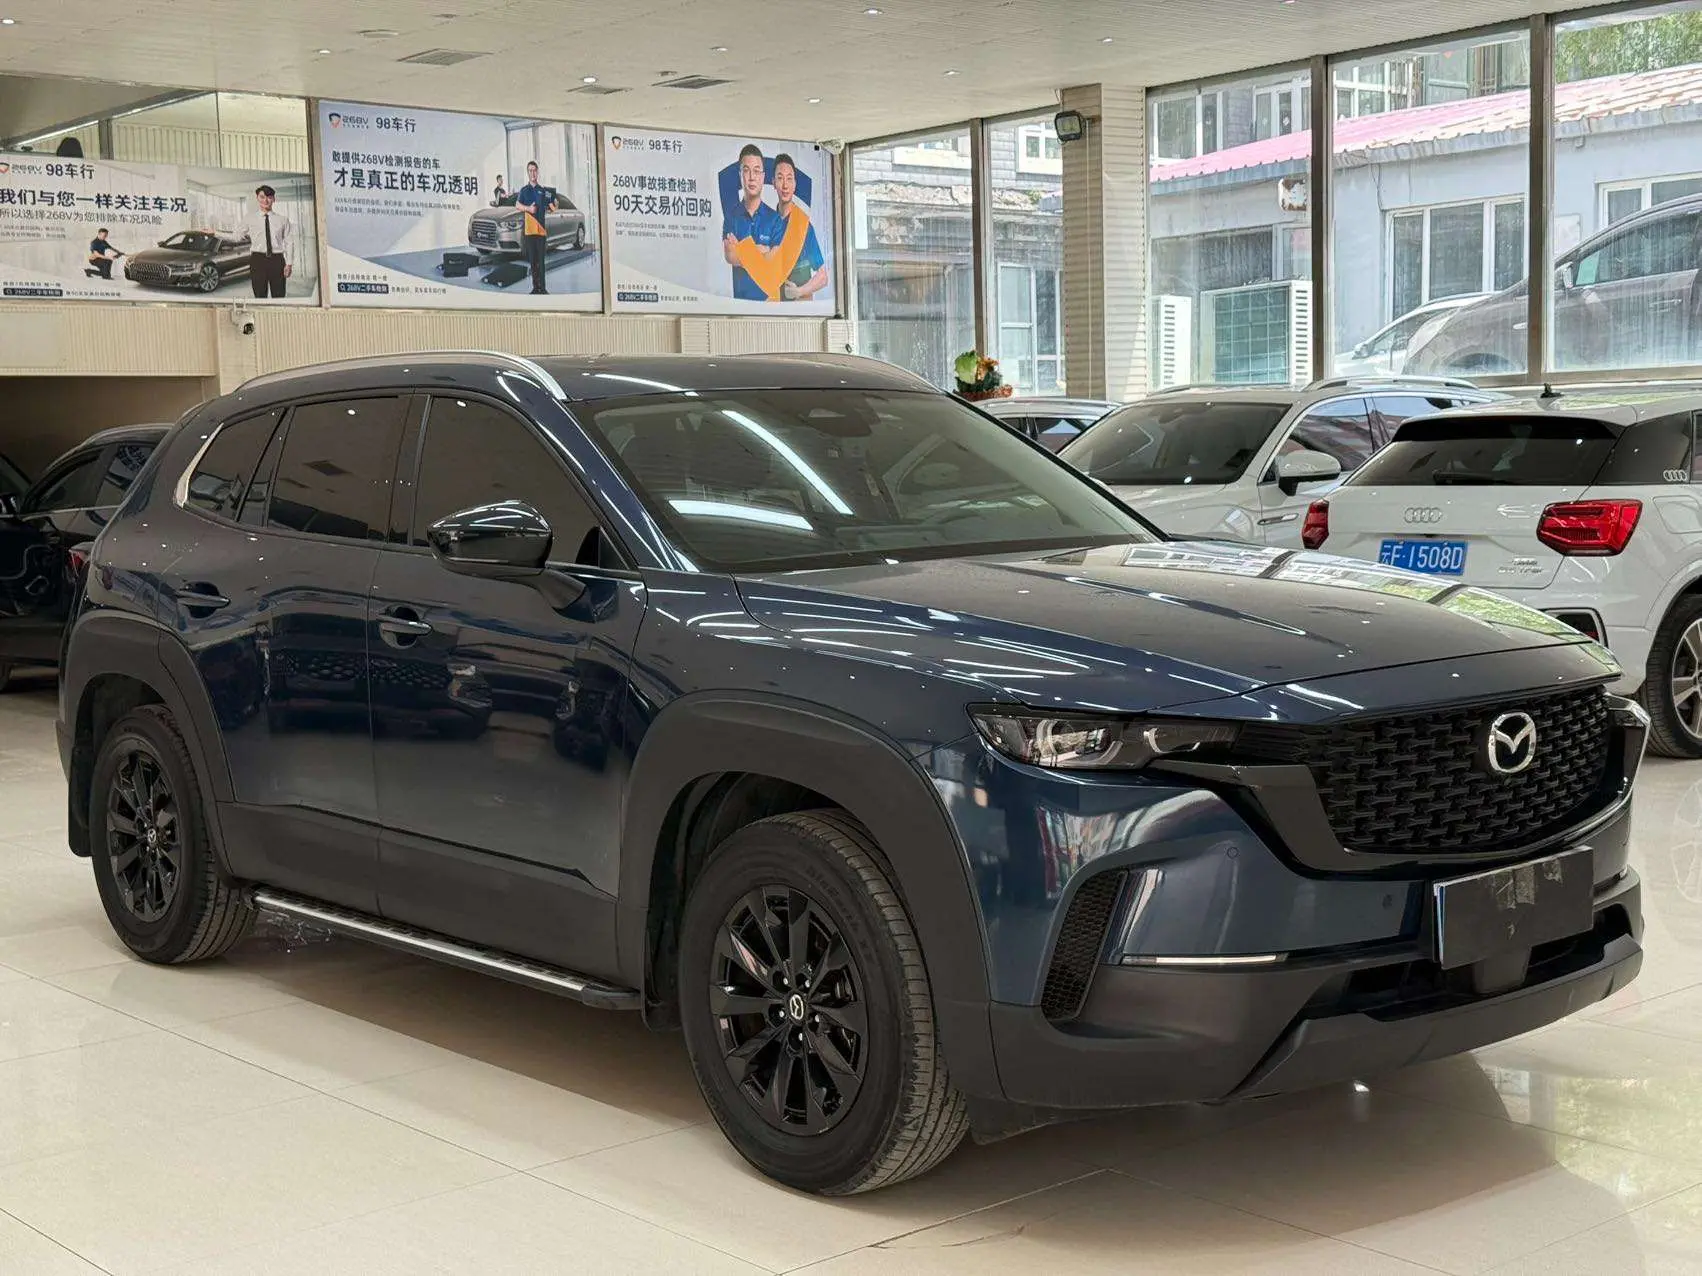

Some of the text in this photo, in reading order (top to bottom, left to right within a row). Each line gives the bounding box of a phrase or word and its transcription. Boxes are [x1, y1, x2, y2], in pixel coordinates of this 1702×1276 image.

[376, 117, 417, 133] 98车行
[648, 139, 683, 153] 98车行
[332, 150, 441, 170] 敢提供268V检测报告的车
[46, 163, 95, 180] 98车行
[334, 166, 479, 196] 才是真正的车况透明
[613, 174, 697, 193] 268V事故排查检测
[0, 188, 188, 213] 我们与您一样关注车况
[614, 194, 712, 218] 90天交易价回购
